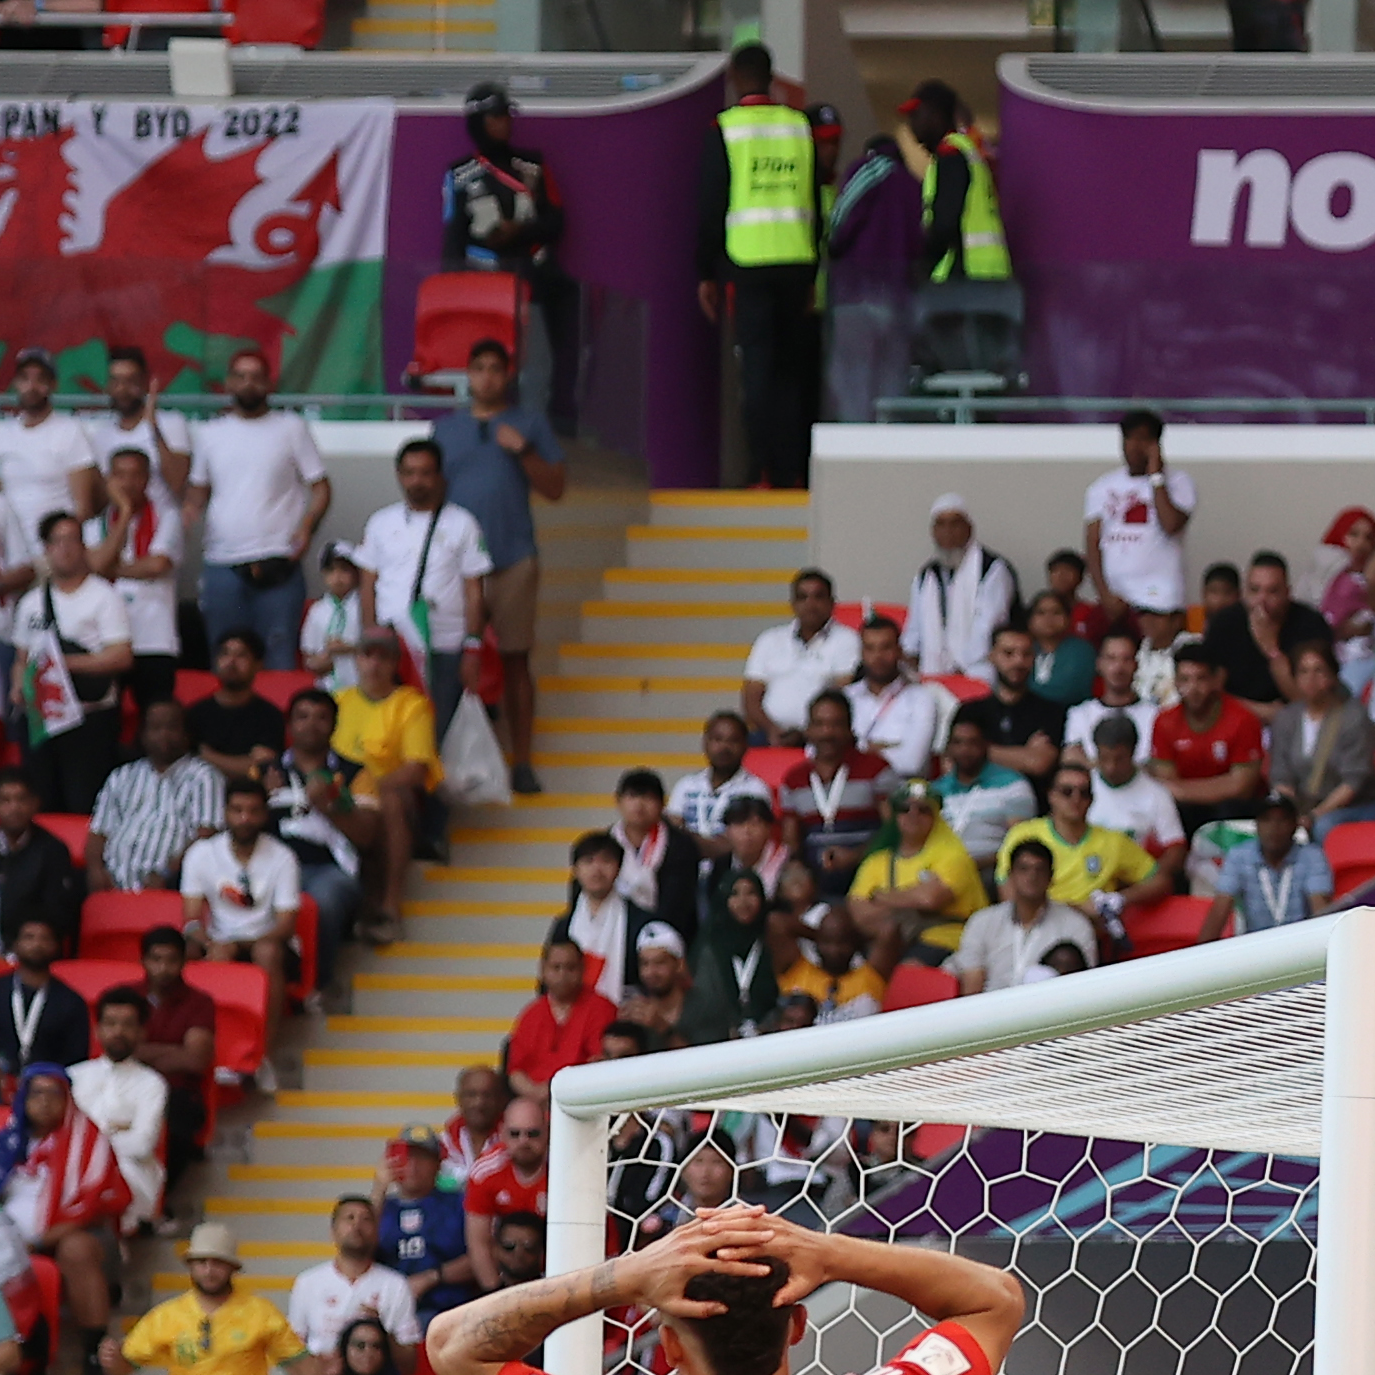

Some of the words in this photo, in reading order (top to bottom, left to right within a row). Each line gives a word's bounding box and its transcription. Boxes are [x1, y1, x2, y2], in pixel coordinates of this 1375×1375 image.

[91, 104, 107, 136] Y
[135, 106, 191, 139] BYD
[224, 104, 302, 138] 2022
